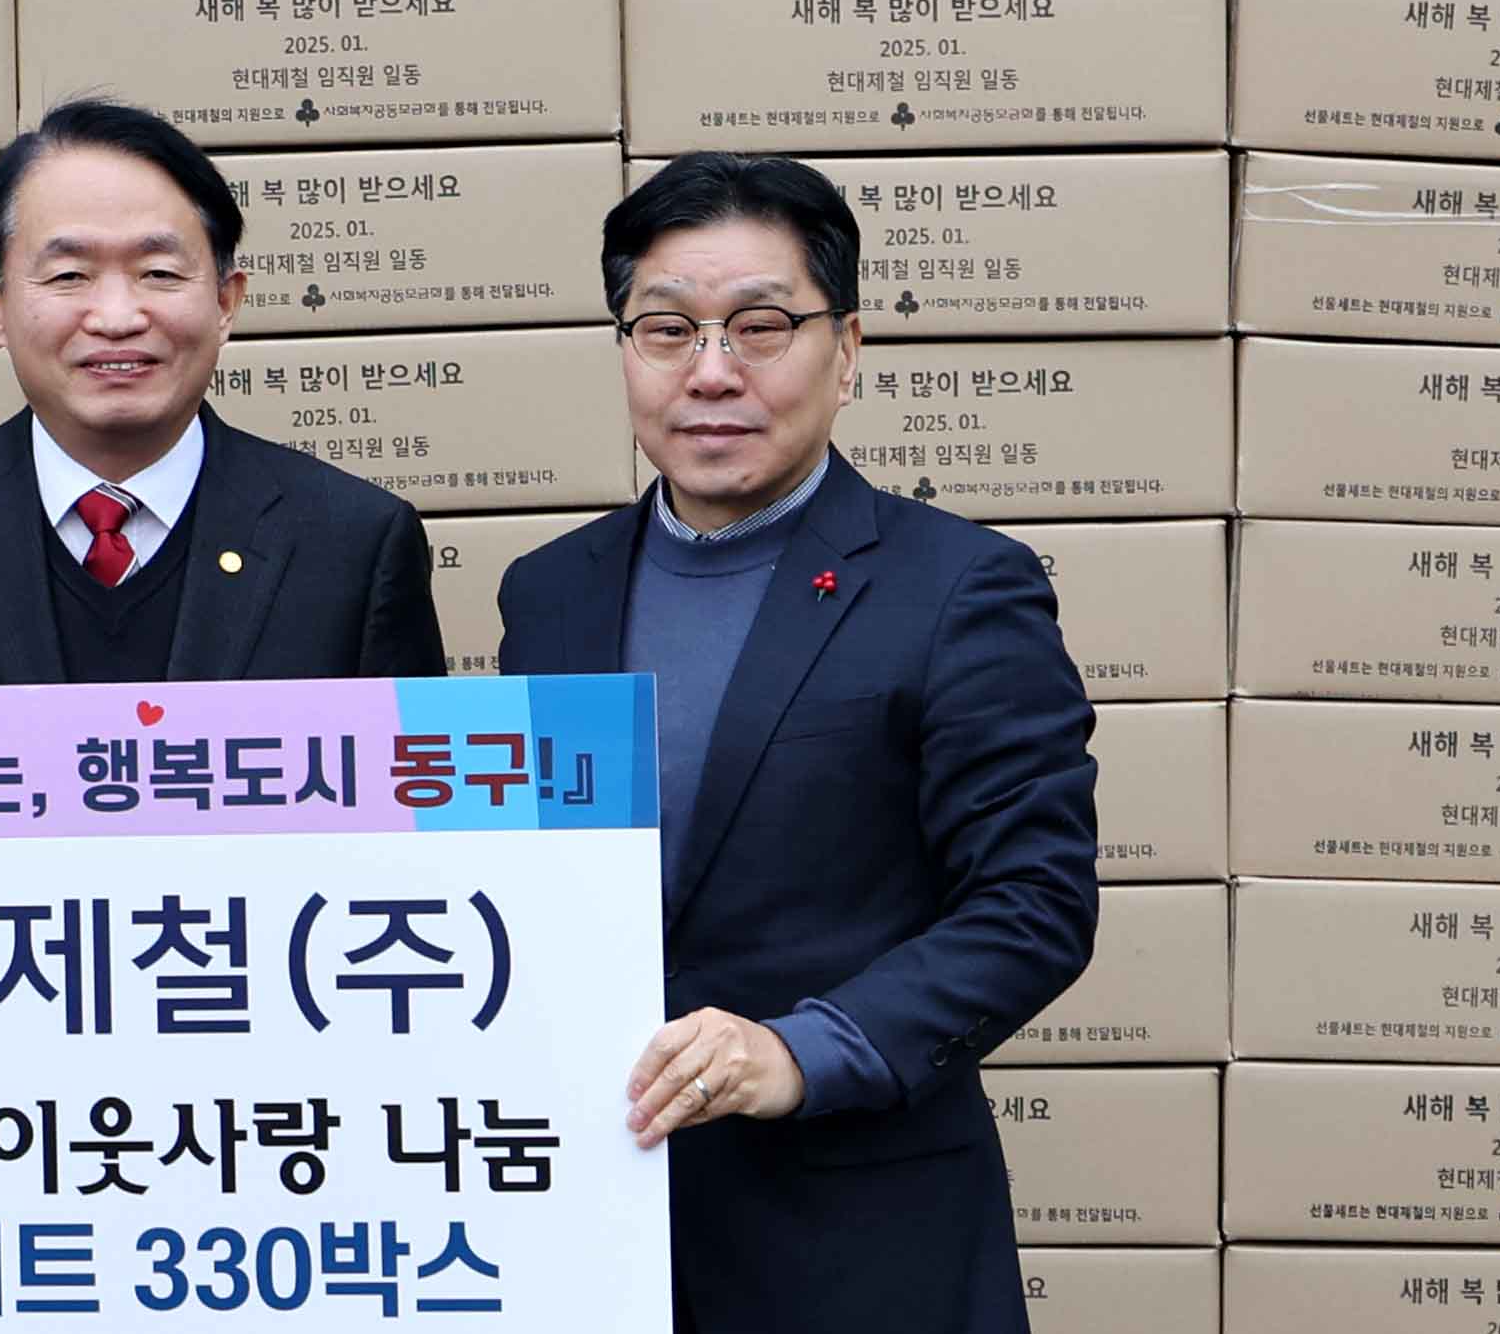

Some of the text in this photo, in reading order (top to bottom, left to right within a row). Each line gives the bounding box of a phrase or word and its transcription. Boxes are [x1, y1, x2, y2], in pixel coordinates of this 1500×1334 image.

[880, 36, 966, 58] 2025. 01.
[827, 68, 1019, 93] 현대제철 임직원 일동
[699, 112, 761, 128] 선물세트는
[766, 110, 827, 126] 현대제철의
[832, 109, 880, 125] 지원으로
[1050, 107, 1076, 122] 통해
[1081, 106, 1146, 121] 전달됩니다.
[1419, 373, 1469, 402] 새해
[1323, 483, 1384, 499] 선물세트는
[1388, 485, 1448, 501] 현대제철의
[1452, 487, 1500, 502] 지원으로
[76, 735, 356, 812] 행복도시
[381, 1097, 560, 1193] 나눔
[134, 1221, 502, 1318] 330박스
